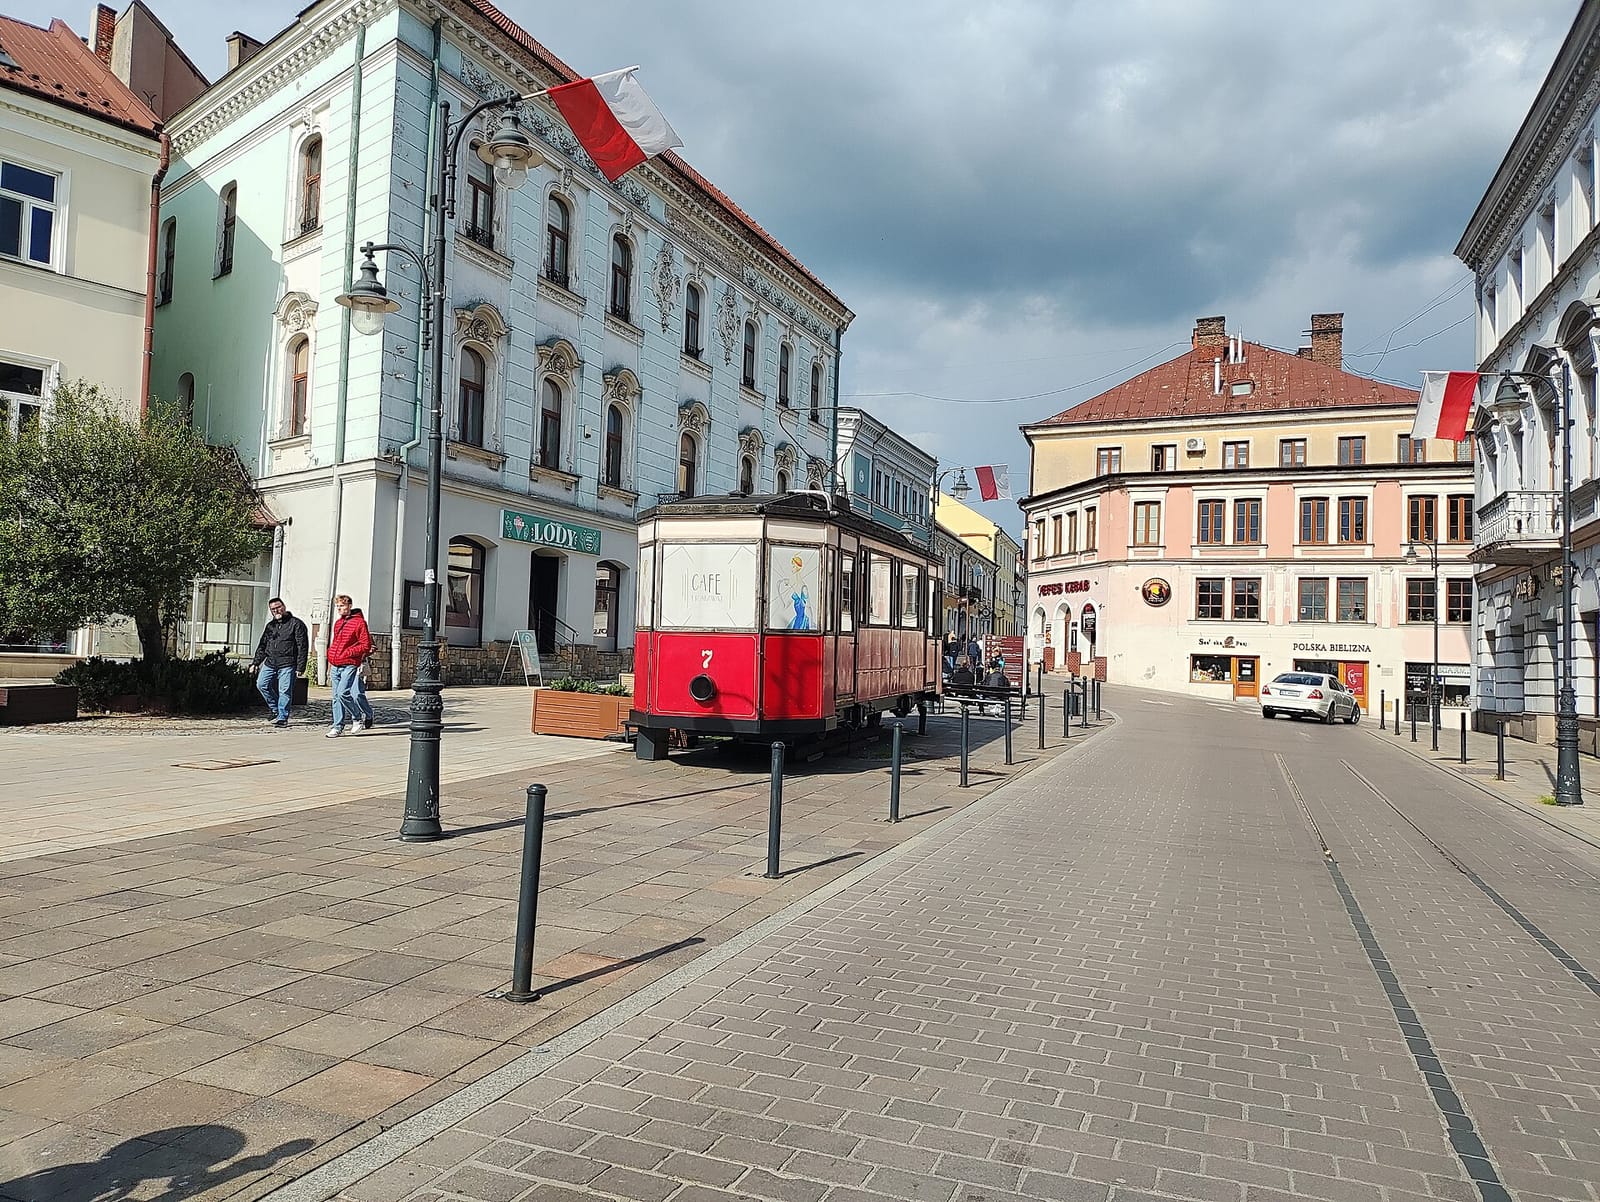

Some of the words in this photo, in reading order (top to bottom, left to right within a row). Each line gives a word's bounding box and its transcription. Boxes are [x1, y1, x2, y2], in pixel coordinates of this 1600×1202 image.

[534, 522, 577, 547] LODY
[691, 573, 721, 595] CAFE
[1065, 580, 1090, 594] KEBAB
[1293, 643, 1327, 651] POLSKA
[1329, 644, 1371, 653] BIELIZNA
[701, 650, 713, 669] 7
